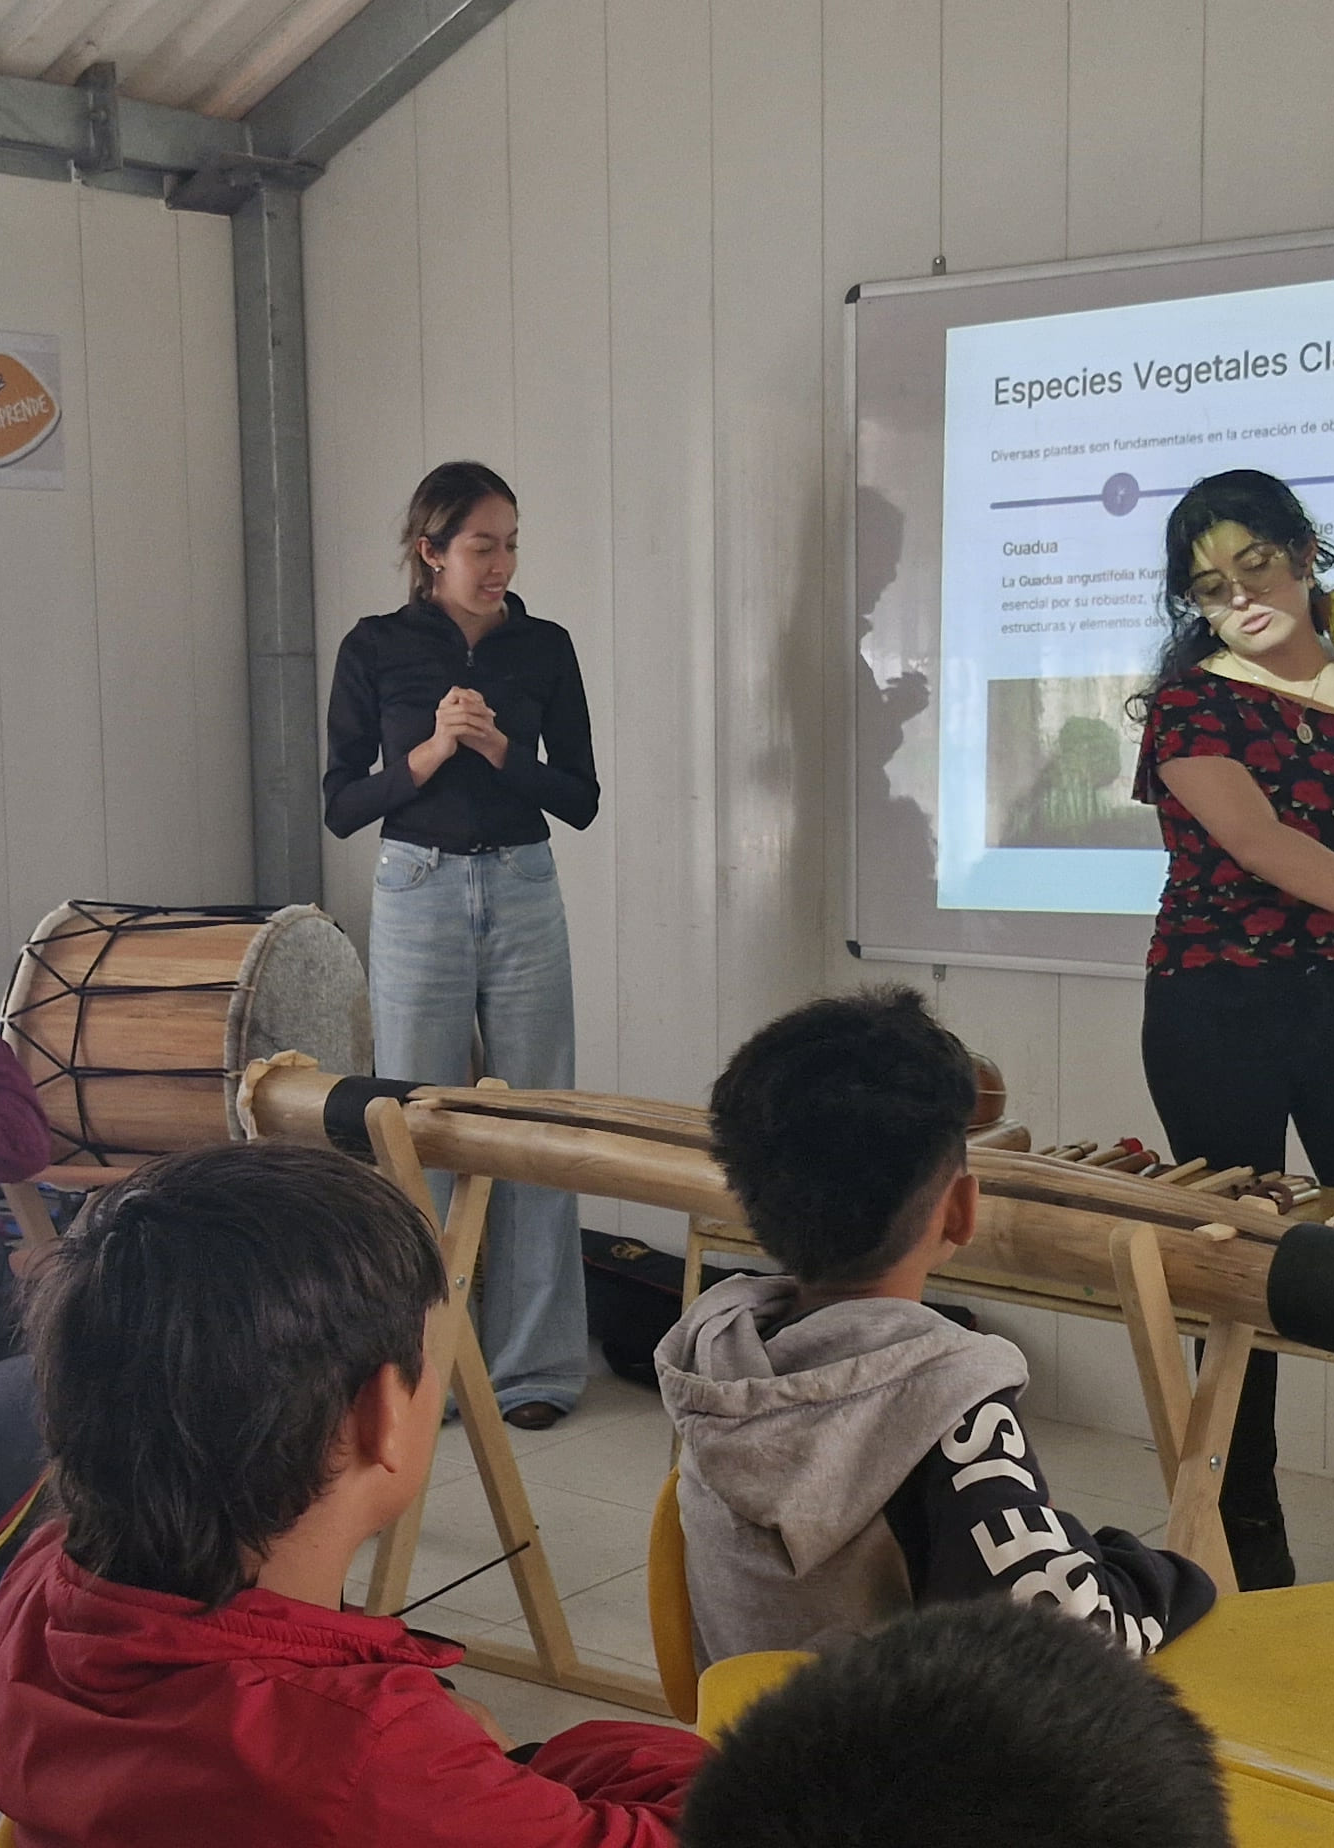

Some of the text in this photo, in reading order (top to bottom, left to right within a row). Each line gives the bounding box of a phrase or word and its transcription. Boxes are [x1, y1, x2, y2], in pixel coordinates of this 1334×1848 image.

[994, 368, 1123, 409] Especies
[1133, 350, 1288, 394] Vegetales
[991, 447, 1041, 463] Diversas
[1043, 443, 1085, 459] plantas
[1089, 440, 1110, 453] son
[1114, 432, 1204, 452] fundamentales
[1207, 430, 1223, 443] en
[1227, 427, 1238, 441] la
[1242, 422, 1297, 441] creación
[1301, 420, 1317, 435] de
[1002, 540, 1058, 557] Guadua
[1002, 576, 1016, 588] La
[1019, 574, 1063, 588] Guadua
[1066, 569, 1135, 586] angustifolia
[1001, 598, 1048, 611] esencial
[1051, 597, 1069, 611] por
[1074, 596, 1089, 608] su
[1001, 619, 1066, 634] estructuras
[1068, 621, 1076, 633] y
[1079, 617, 1141, 631] elementos
